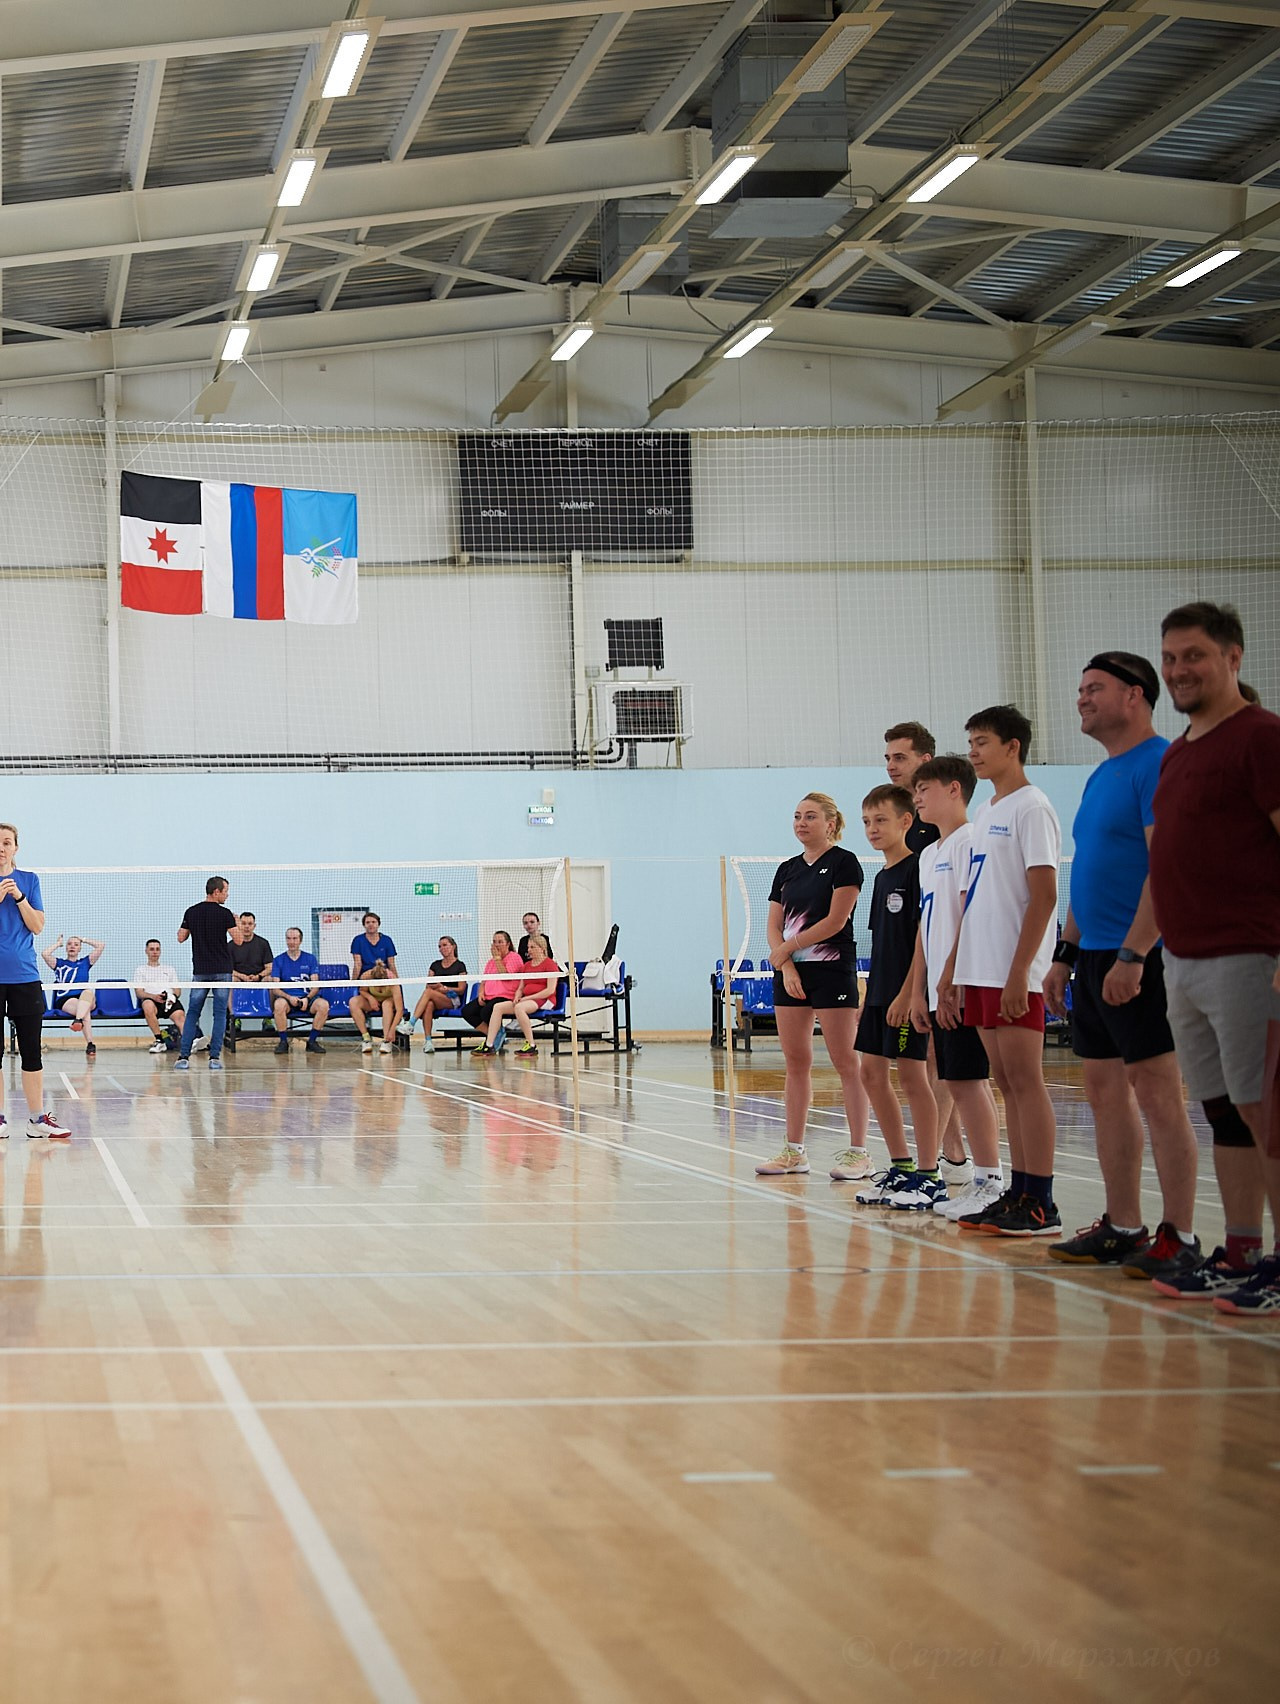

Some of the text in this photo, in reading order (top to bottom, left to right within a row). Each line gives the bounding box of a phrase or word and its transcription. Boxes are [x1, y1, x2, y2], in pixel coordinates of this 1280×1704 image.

[558, 438, 593, 448] ПЕРИОД
[559, 500, 595, 510] ТАЙМЕР
[481, 509, 507, 517] ФОЛЫ
[646, 507, 672, 515] ФОЛЫ
